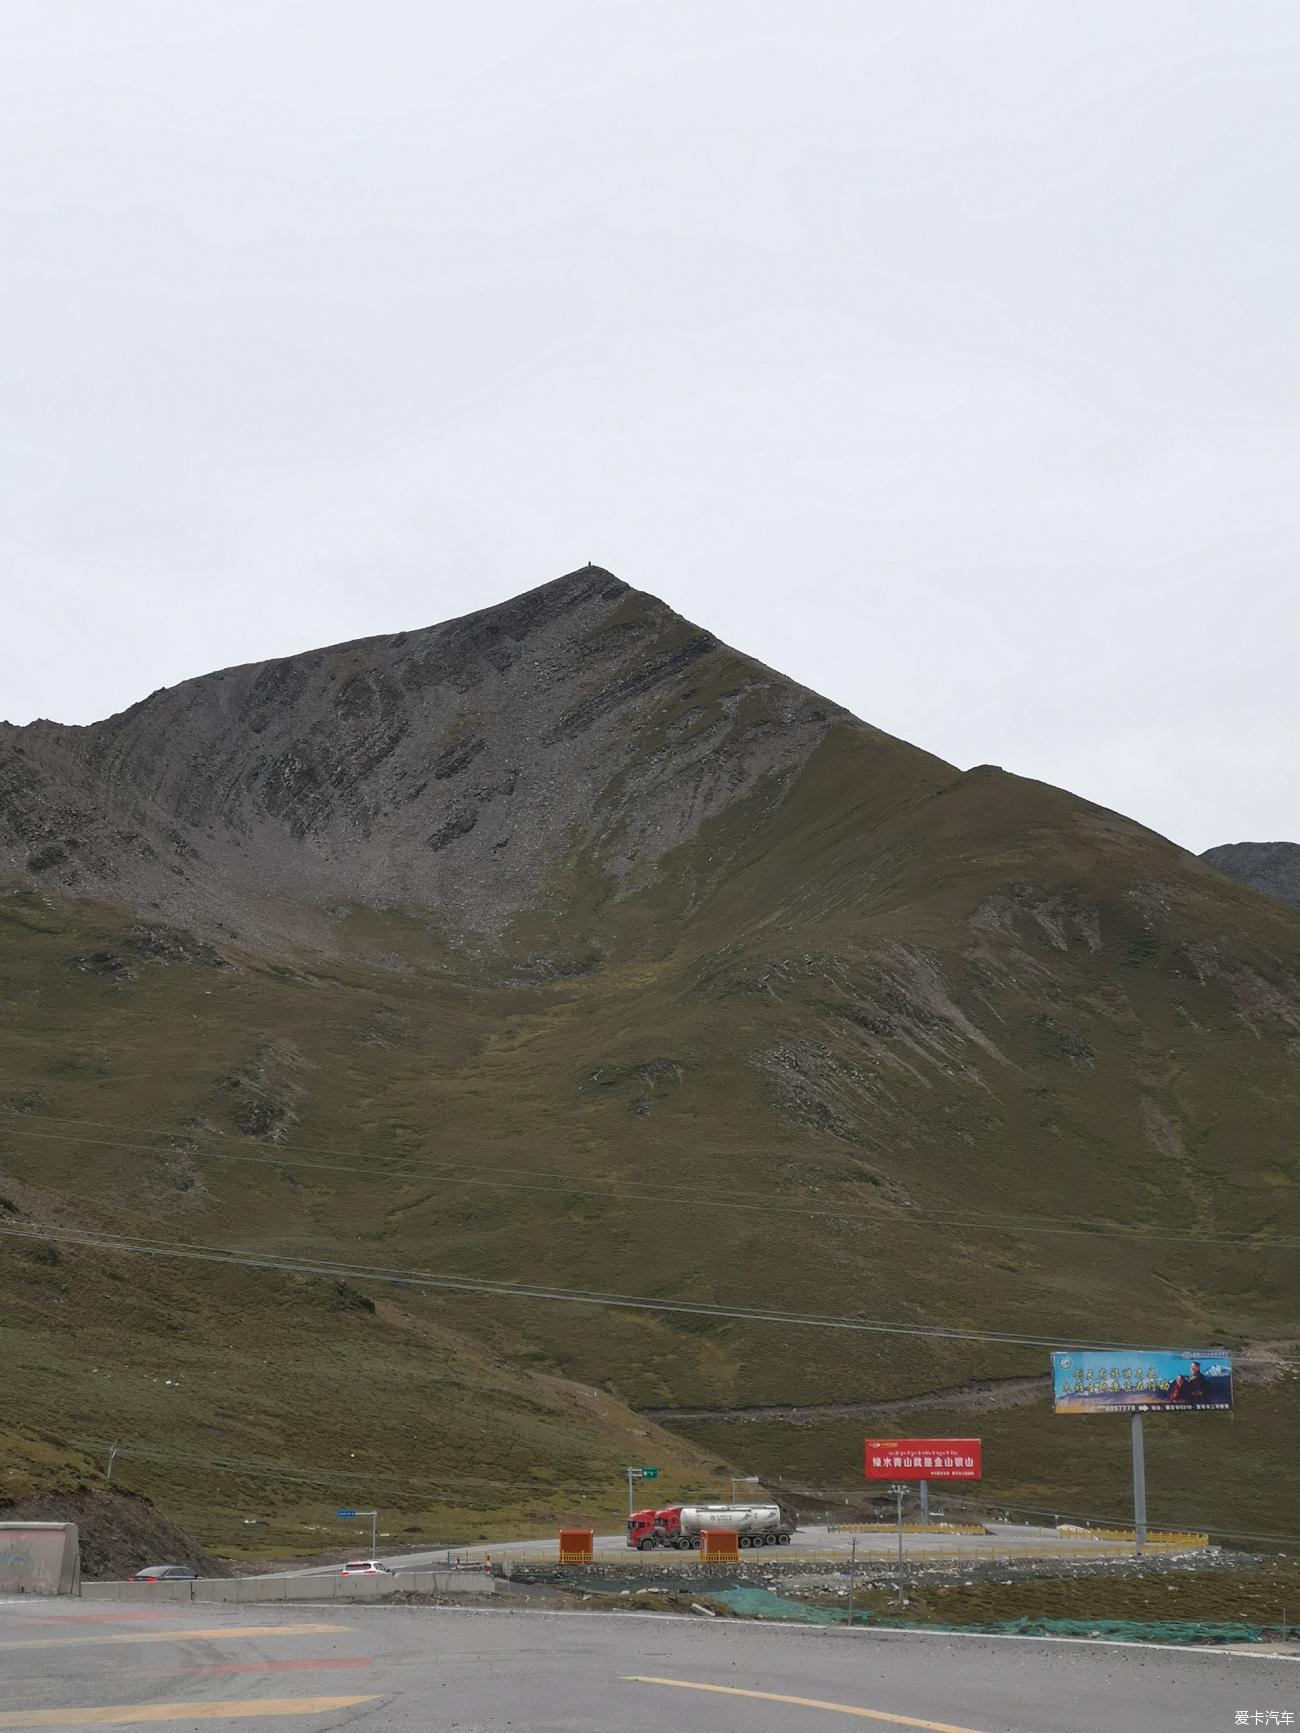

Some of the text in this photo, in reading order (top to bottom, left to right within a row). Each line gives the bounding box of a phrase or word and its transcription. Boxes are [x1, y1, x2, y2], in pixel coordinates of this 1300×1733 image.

[872, 1457, 974, 1468] 绿水青山就是金山银山
